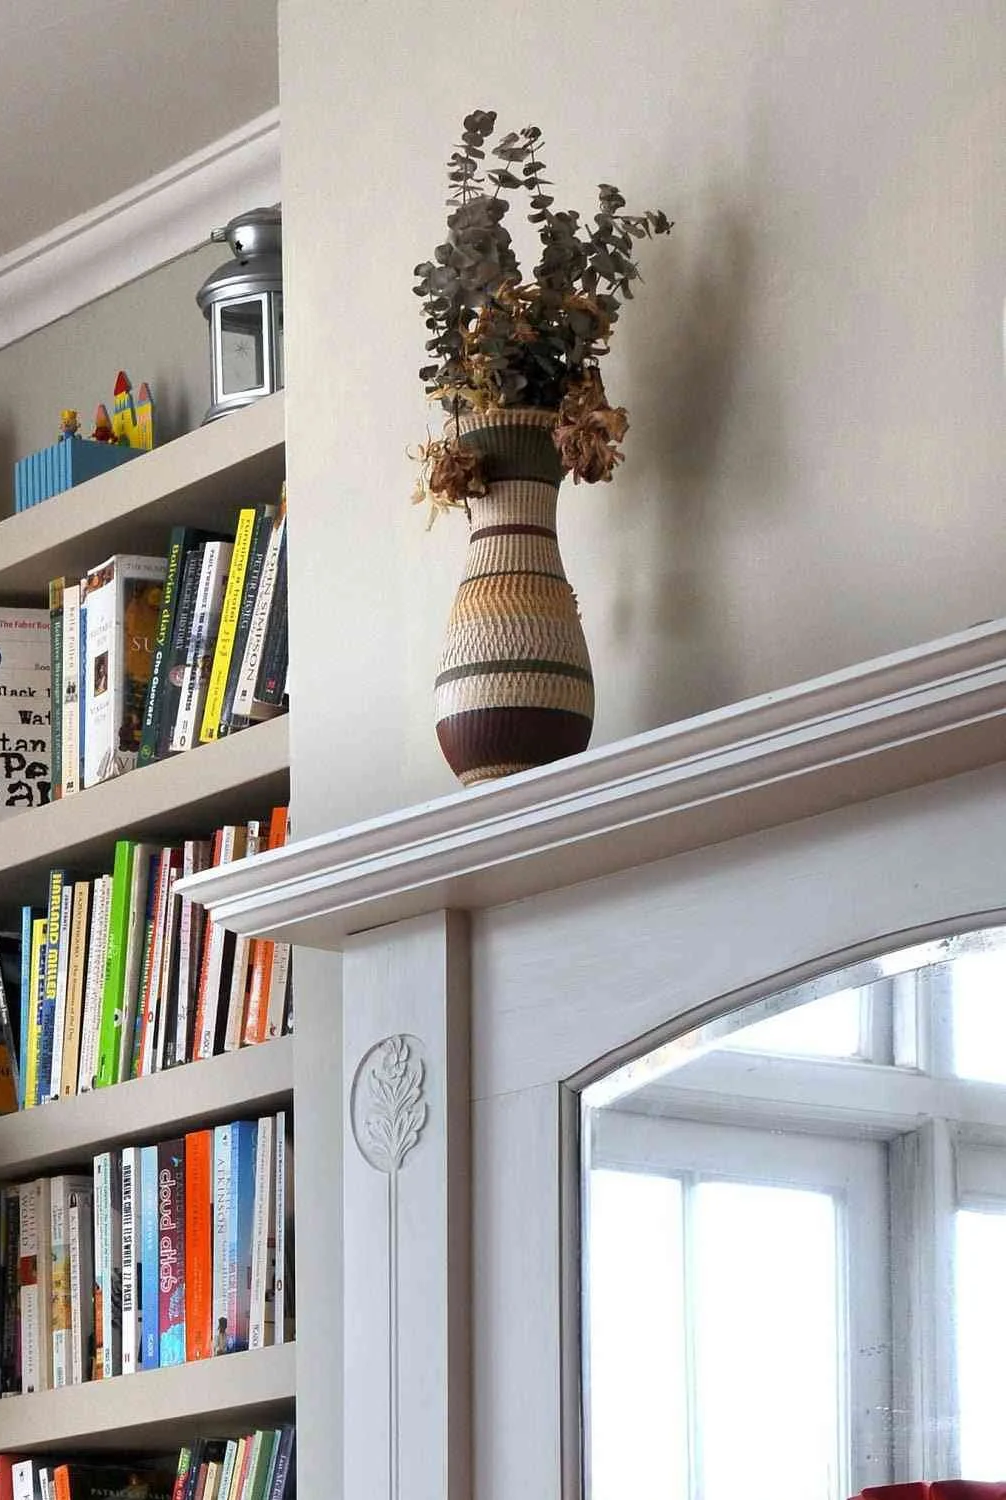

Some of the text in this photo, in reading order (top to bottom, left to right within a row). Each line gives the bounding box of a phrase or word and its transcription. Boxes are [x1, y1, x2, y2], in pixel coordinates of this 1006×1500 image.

[236, 519, 251, 572] running
[156, 544, 178, 646] Bolivian diary
[227, 588, 241, 623] hotel
[245, 546, 279, 682] JOHN SIMPSON
[14, 620, 36, 630] Faber
[146, 650, 164, 726] Che Guevara
[50, 874, 62, 944] HARLAND
[46, 948, 58, 1000] MILLER
[123, 1165, 132, 1201] DRINKING
[123, 1202, 132, 1225] COFFEE
[159, 1168, 178, 1293] cloud atlas
[123, 1228, 132, 1268] ELSEWHERE
